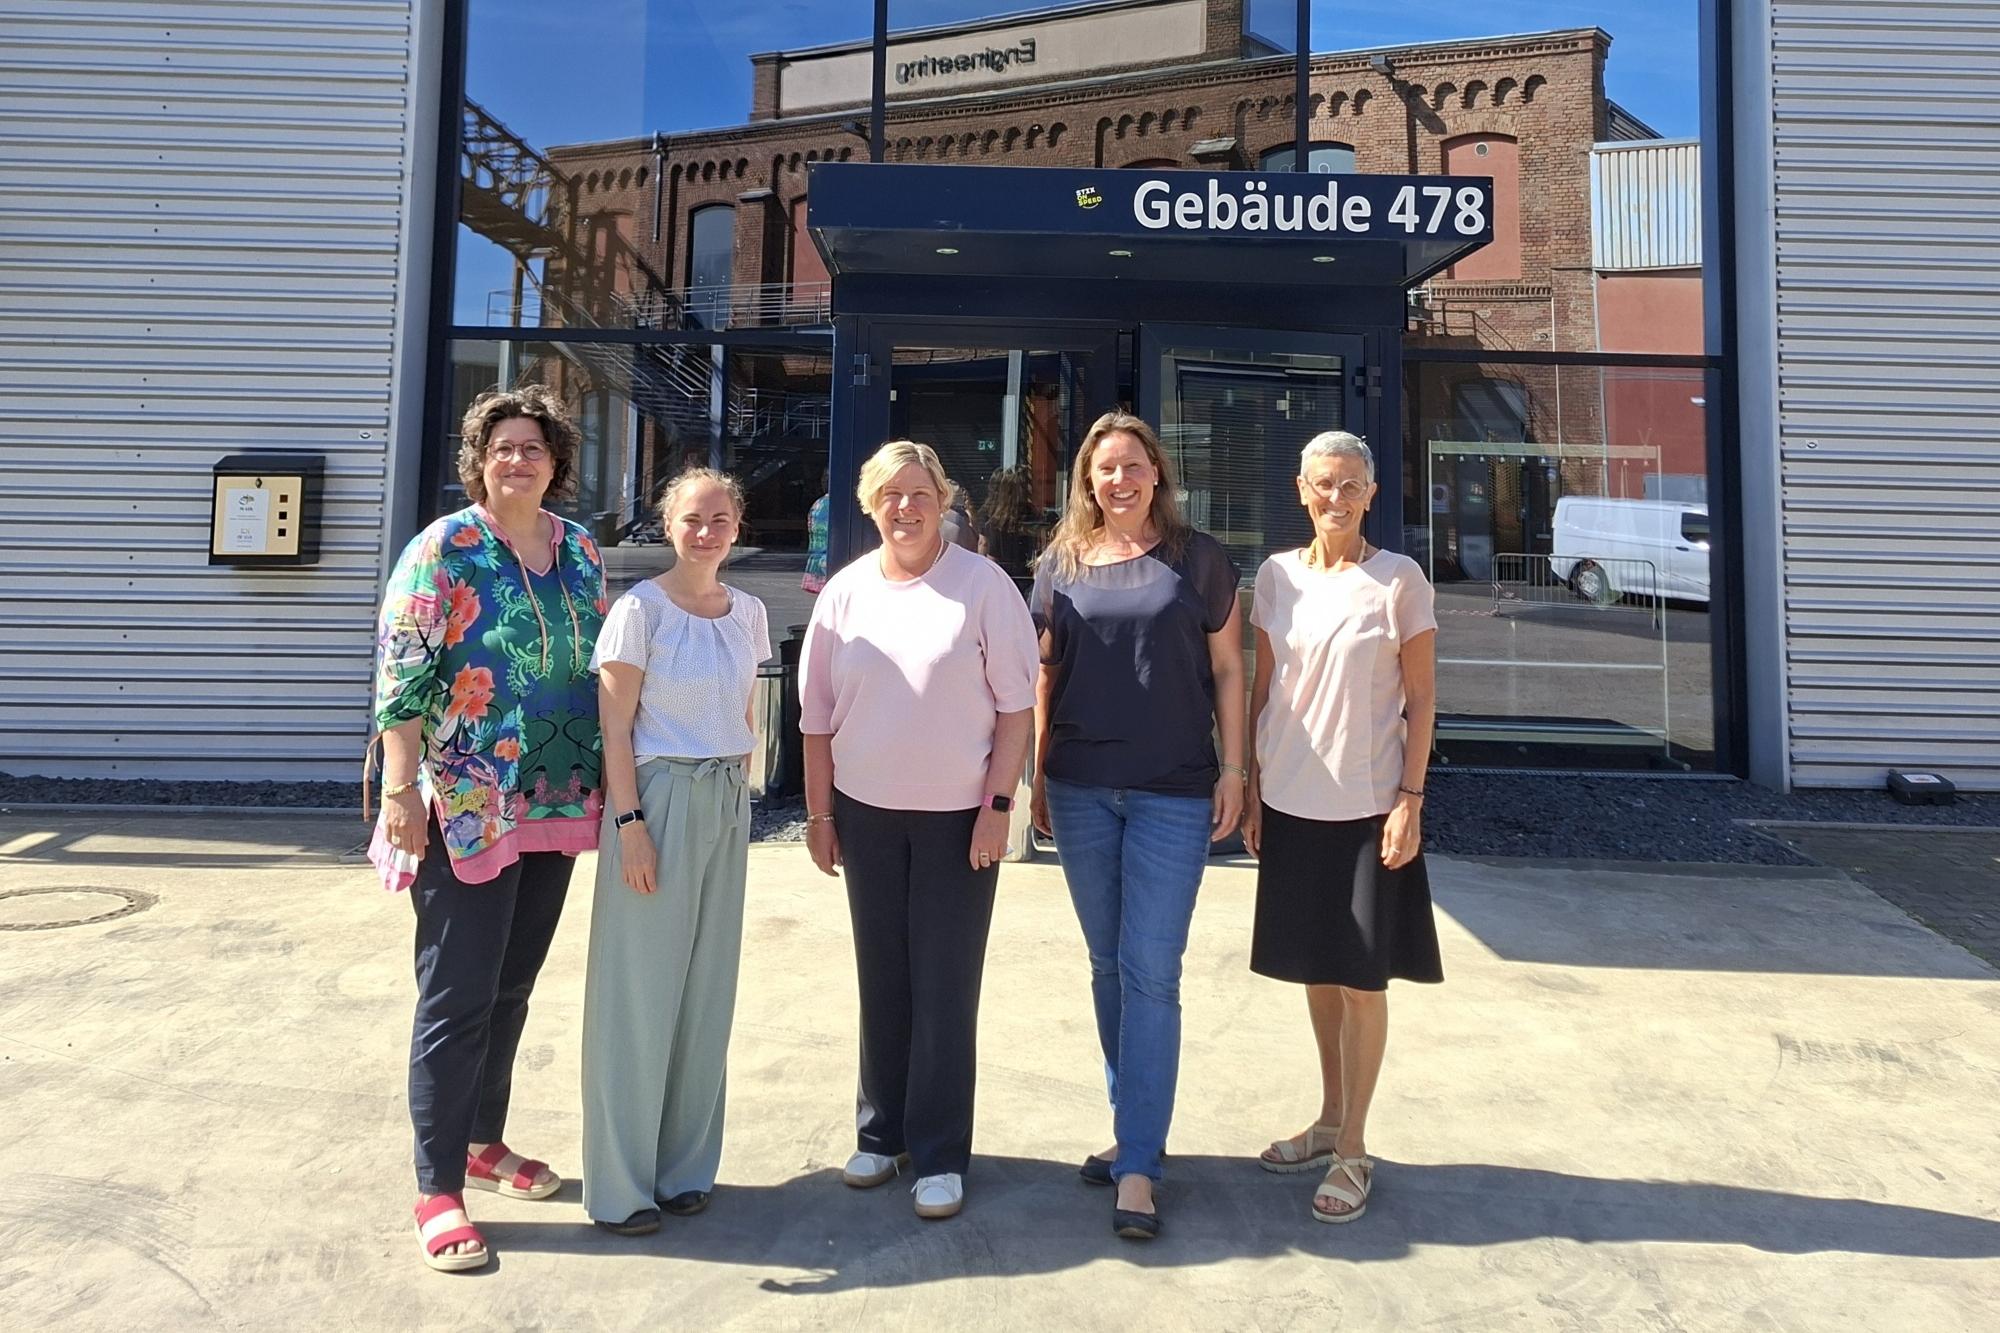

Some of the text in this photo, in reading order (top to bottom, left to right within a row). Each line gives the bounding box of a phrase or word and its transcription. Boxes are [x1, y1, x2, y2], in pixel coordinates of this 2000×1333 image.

[1078, 195, 1103, 207] SPEED
[1133, 178, 1486, 236] Gebäude 478
